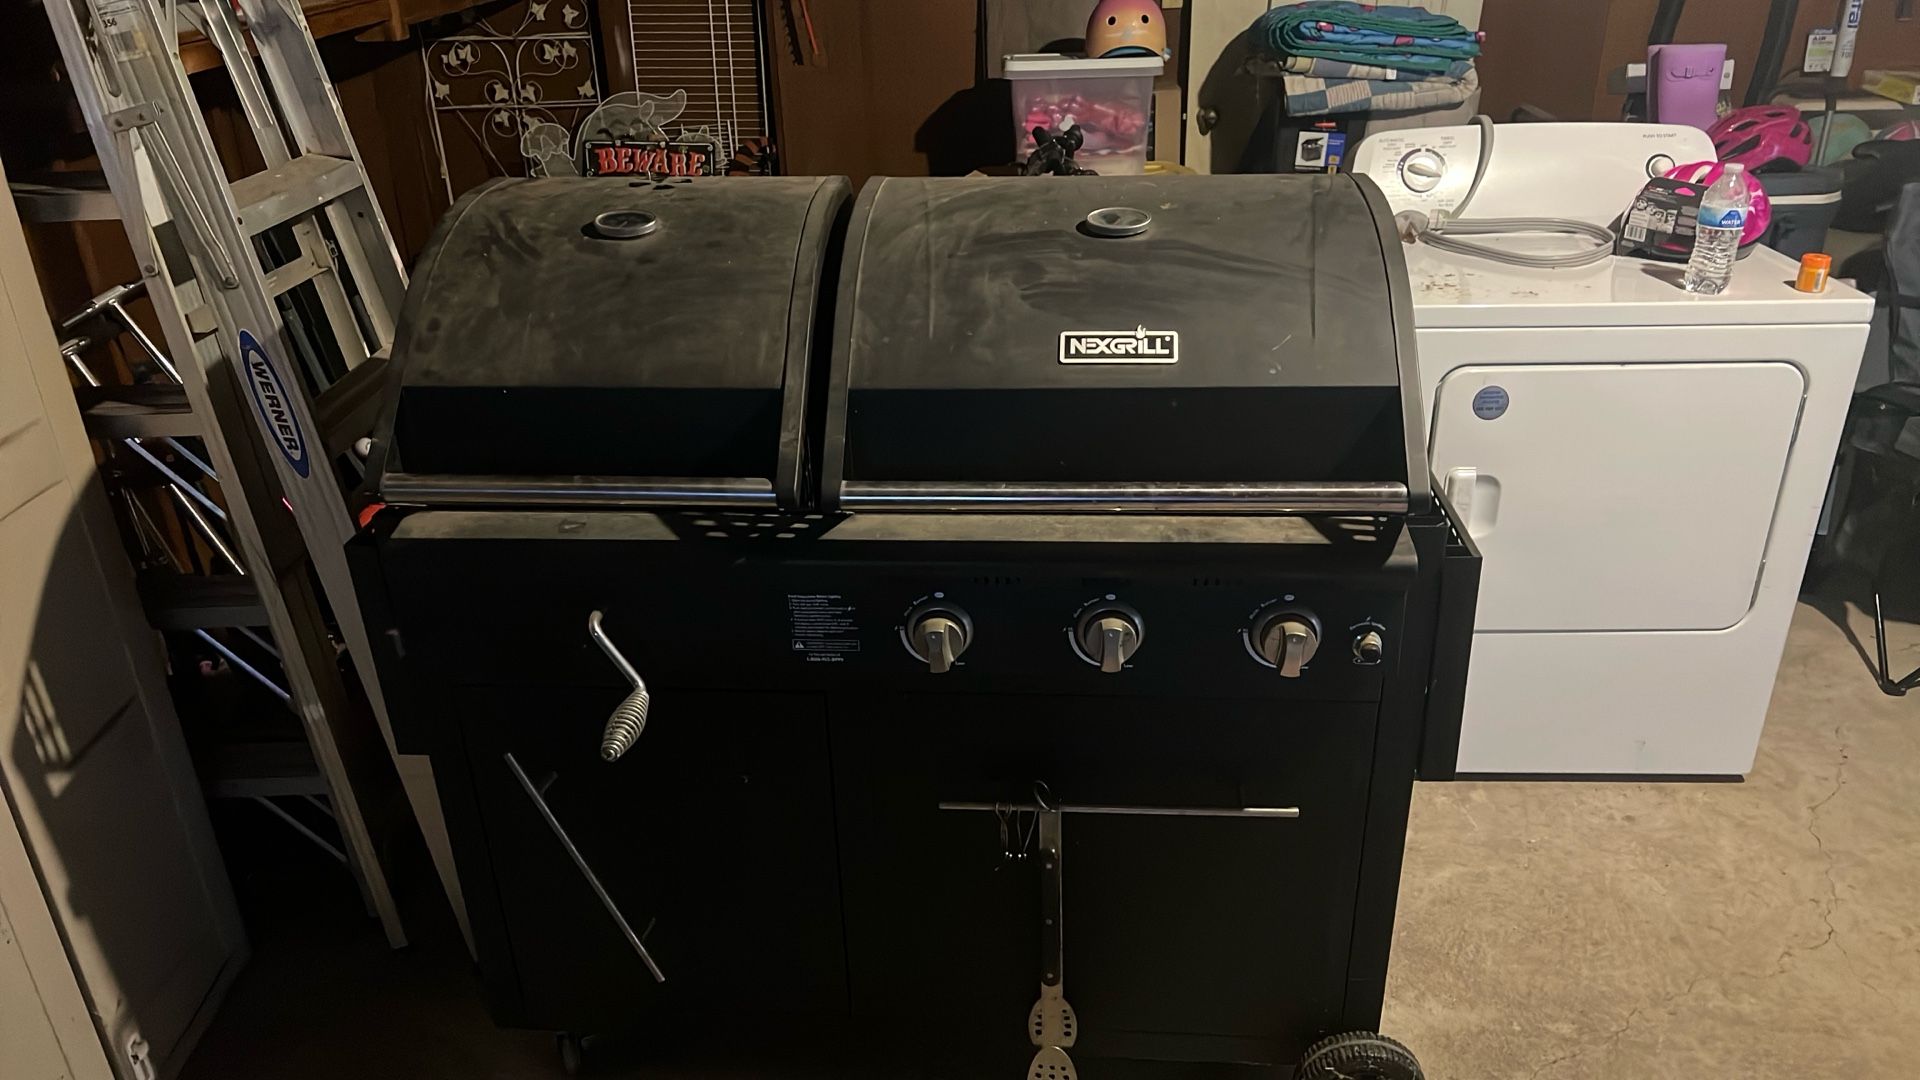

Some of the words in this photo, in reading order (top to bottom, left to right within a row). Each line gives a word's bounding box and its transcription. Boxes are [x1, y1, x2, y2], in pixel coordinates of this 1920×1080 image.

[1847, 0, 1861, 28] ral
[595, 147, 705, 177] BEWARE
[1070, 338, 1170, 354] NEXGRILL
[251, 361, 300, 452] WERNER
